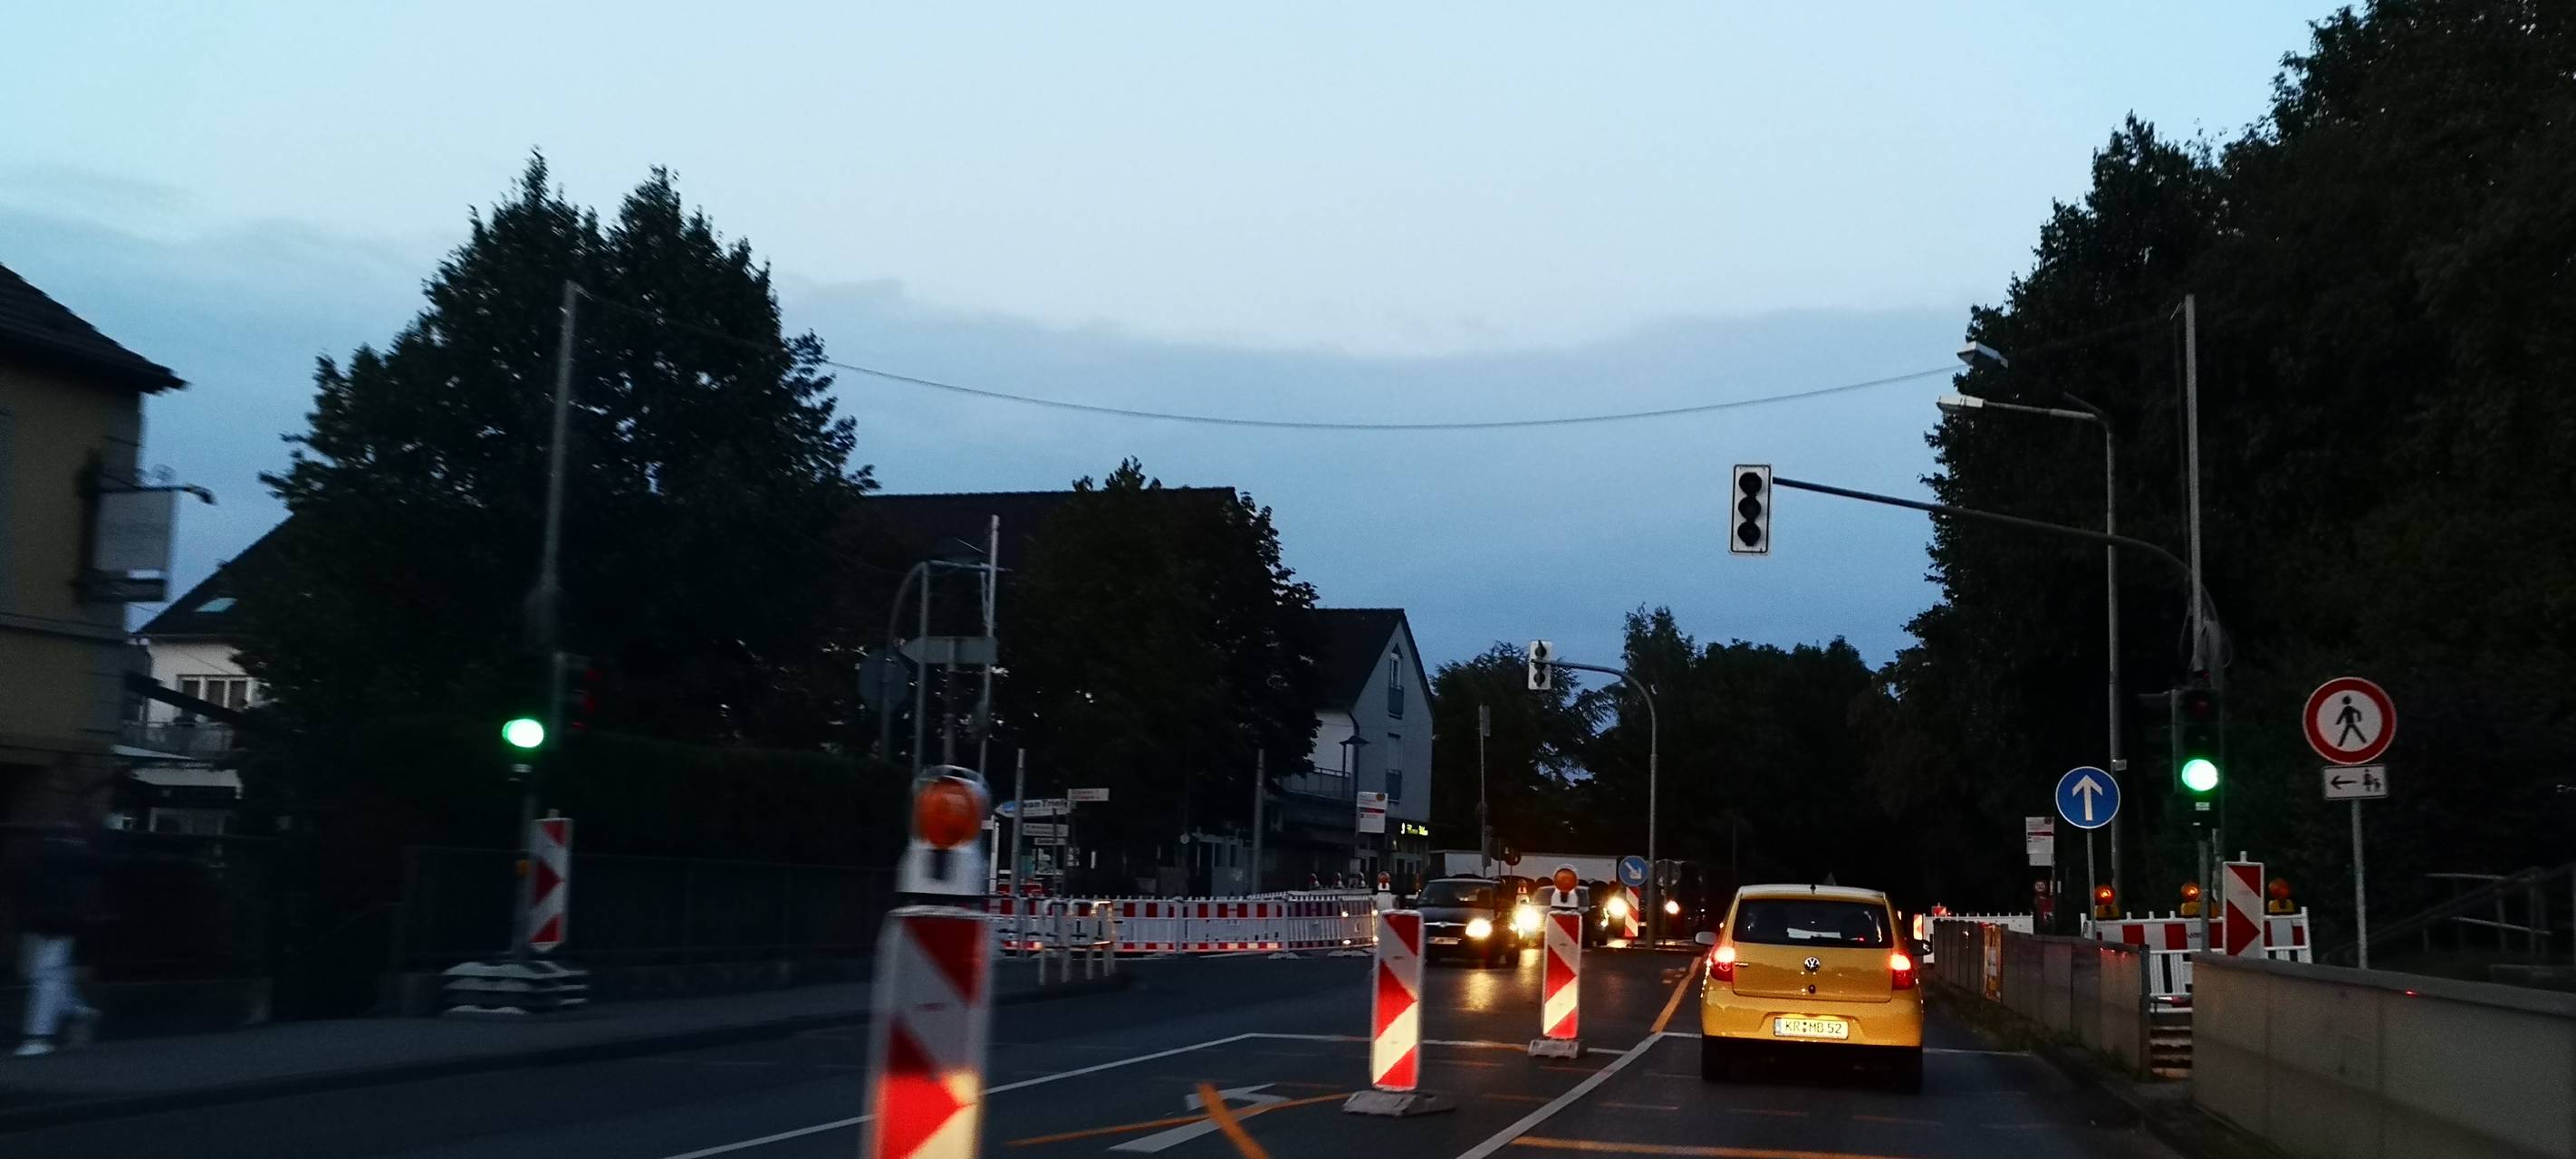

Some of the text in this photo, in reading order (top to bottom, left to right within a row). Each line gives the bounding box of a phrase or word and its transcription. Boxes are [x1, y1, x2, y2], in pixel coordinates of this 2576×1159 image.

[1785, 1020, 1842, 1034] KR MB 52
